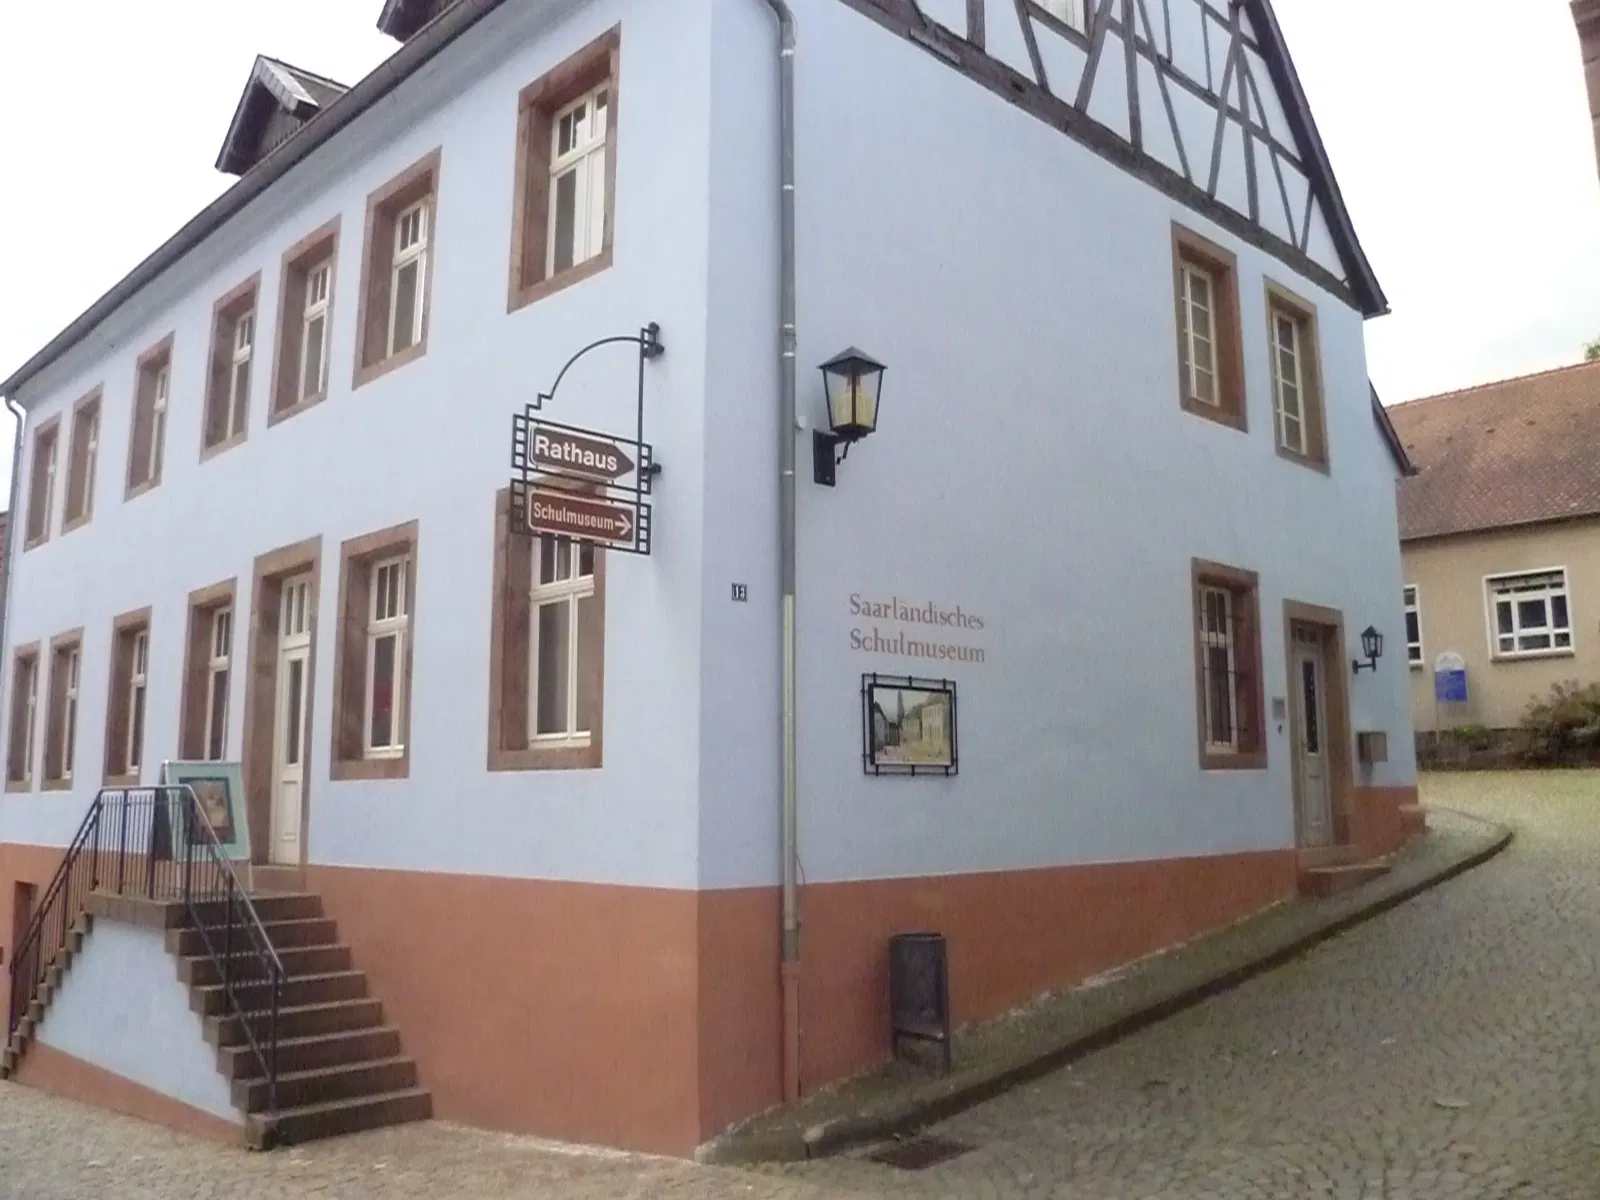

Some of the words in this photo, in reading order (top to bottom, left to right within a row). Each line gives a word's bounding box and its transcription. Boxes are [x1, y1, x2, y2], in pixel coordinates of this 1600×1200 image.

[534, 434, 617, 471] Rathaus
[533, 502, 614, 531] Schulmuseum
[849, 592, 985, 630] Saarländisches
[849, 627, 985, 663] Schulmuseum
